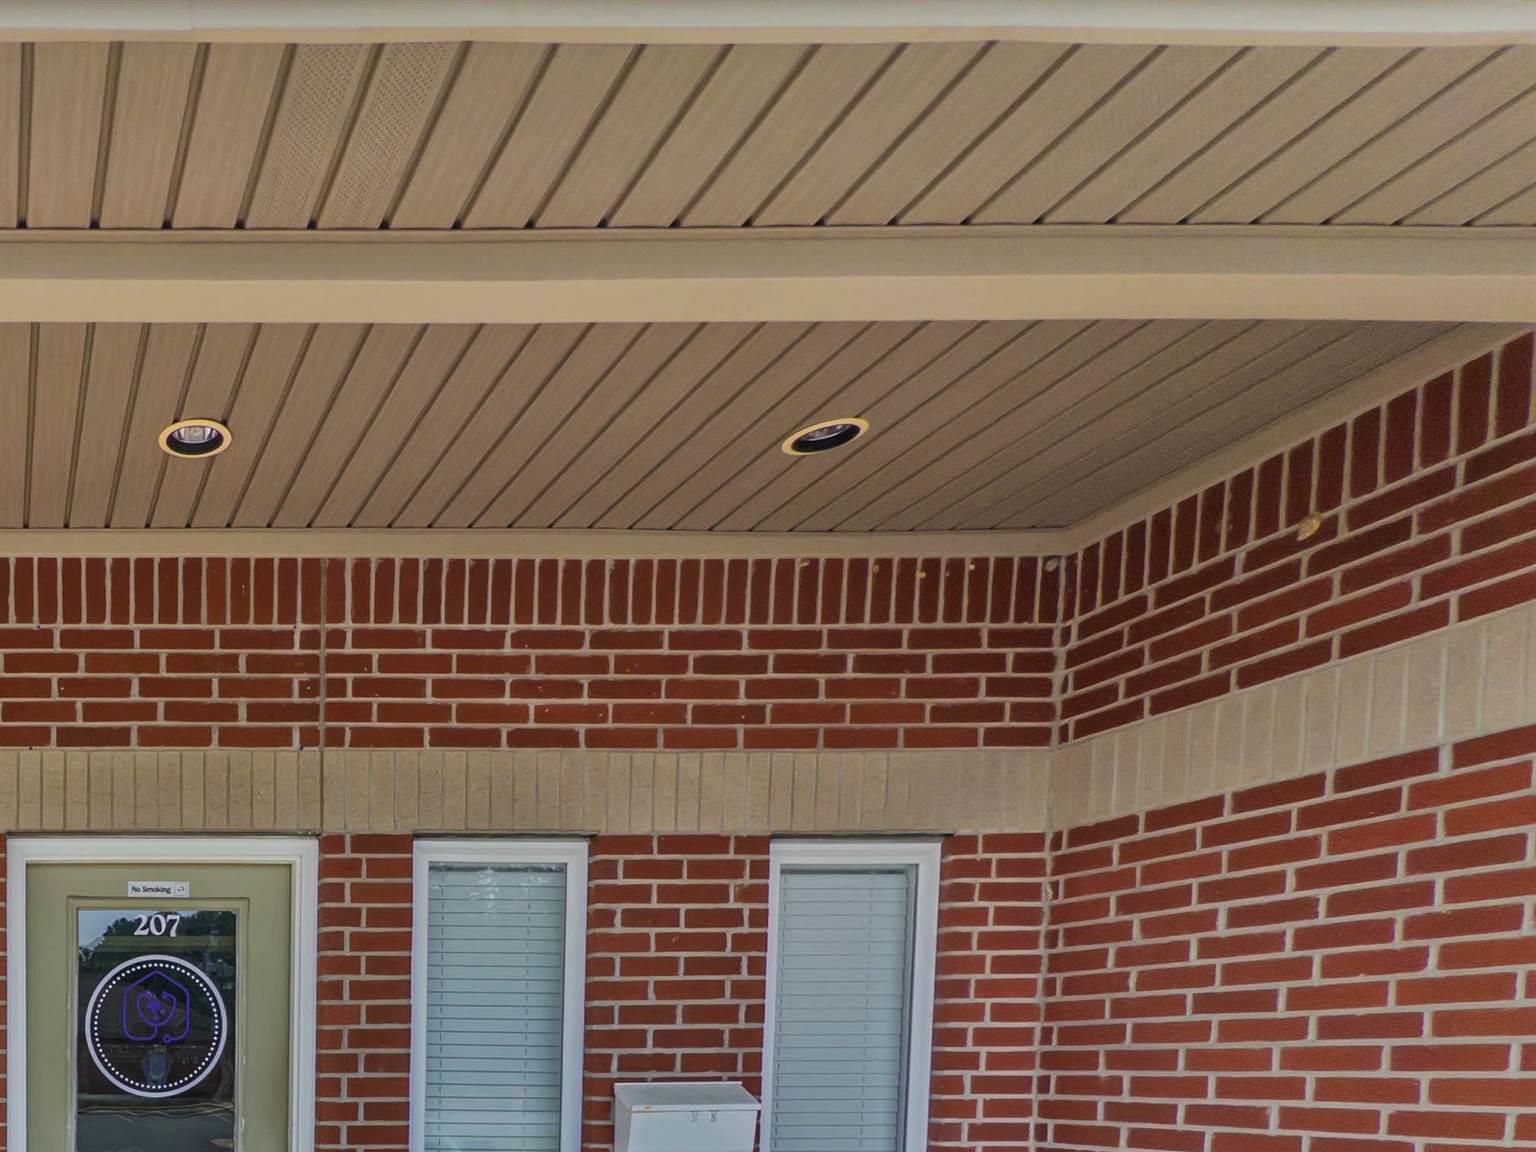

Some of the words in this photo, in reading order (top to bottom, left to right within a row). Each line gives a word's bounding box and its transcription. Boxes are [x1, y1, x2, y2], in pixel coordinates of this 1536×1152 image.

[131, 885, 142, 893] No
[142, 885, 171, 895] Smoking
[133, 914, 181, 938] 207
